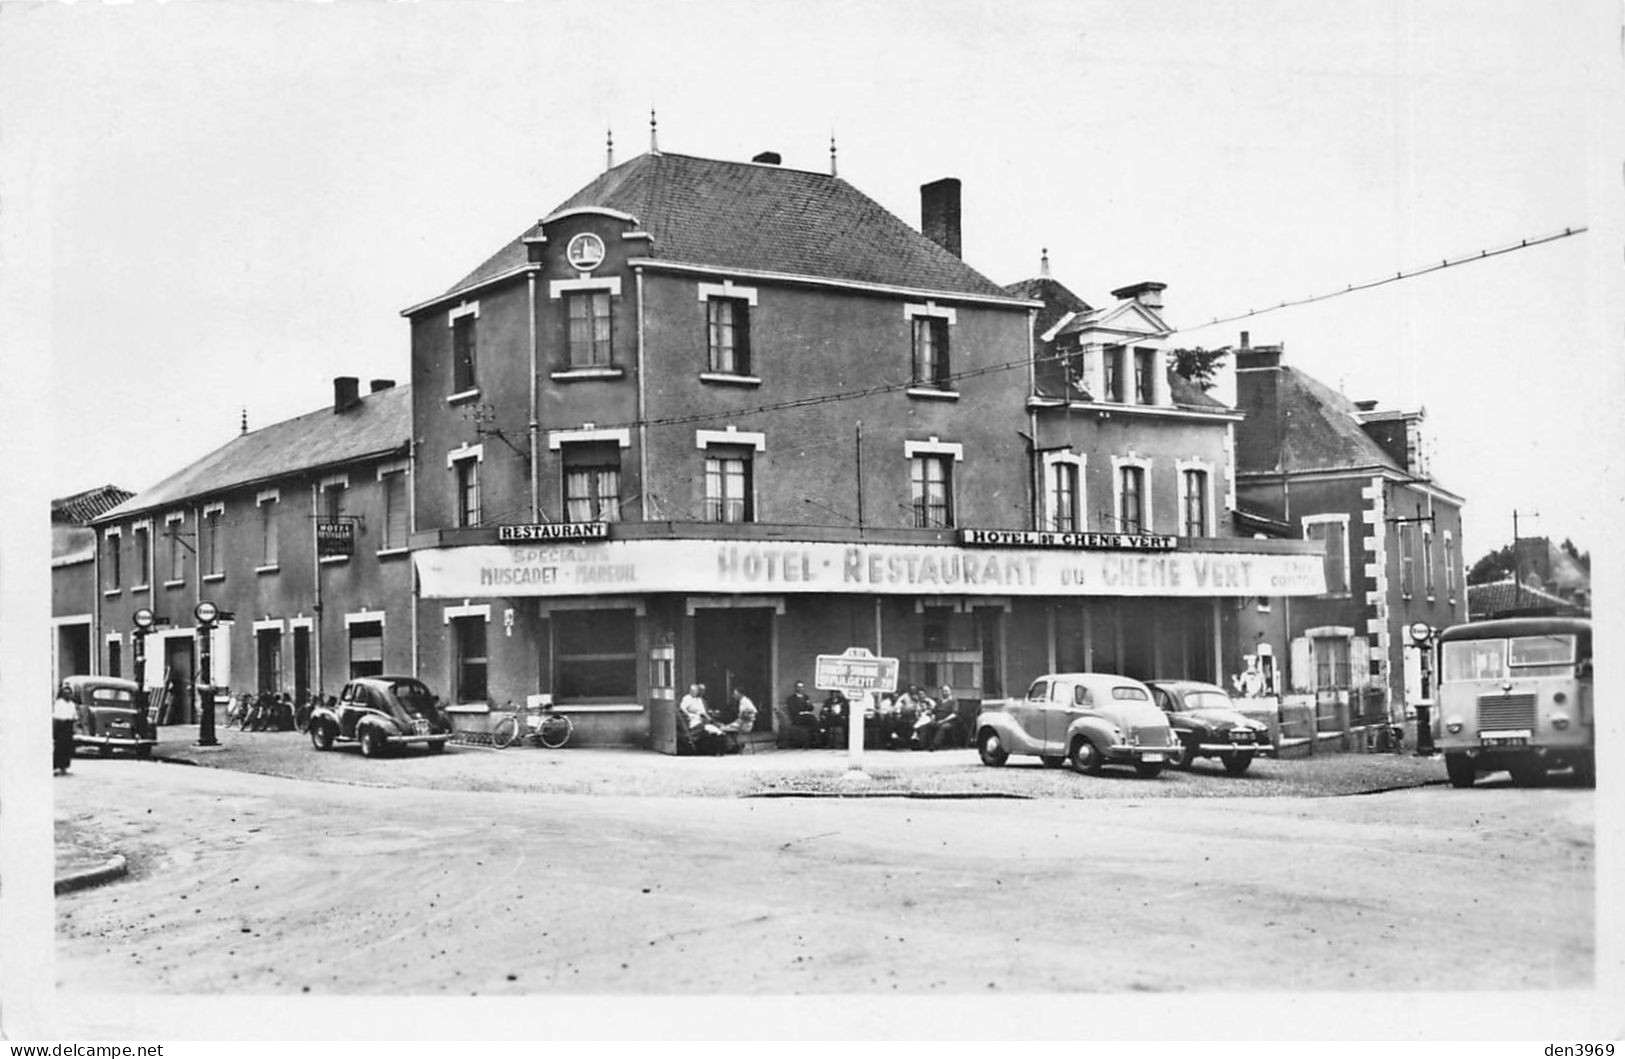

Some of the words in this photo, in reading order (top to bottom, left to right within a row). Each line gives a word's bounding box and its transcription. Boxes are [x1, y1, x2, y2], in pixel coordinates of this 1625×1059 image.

[502, 523, 607, 539] RESTAURANT
[973, 531, 1034, 544] HOTEL
[1062, 534, 1122, 547] CHENE
[1128, 536, 1172, 549] VERT
[481, 567, 559, 586] MUSCADET
[575, 564, 639, 584] MAREUIL
[717, 548, 817, 583] HOTEL
[843, 549, 1042, 585] RESTAURANT
[1061, 568, 1085, 586] DU
[1193, 558, 1253, 588] VERT
